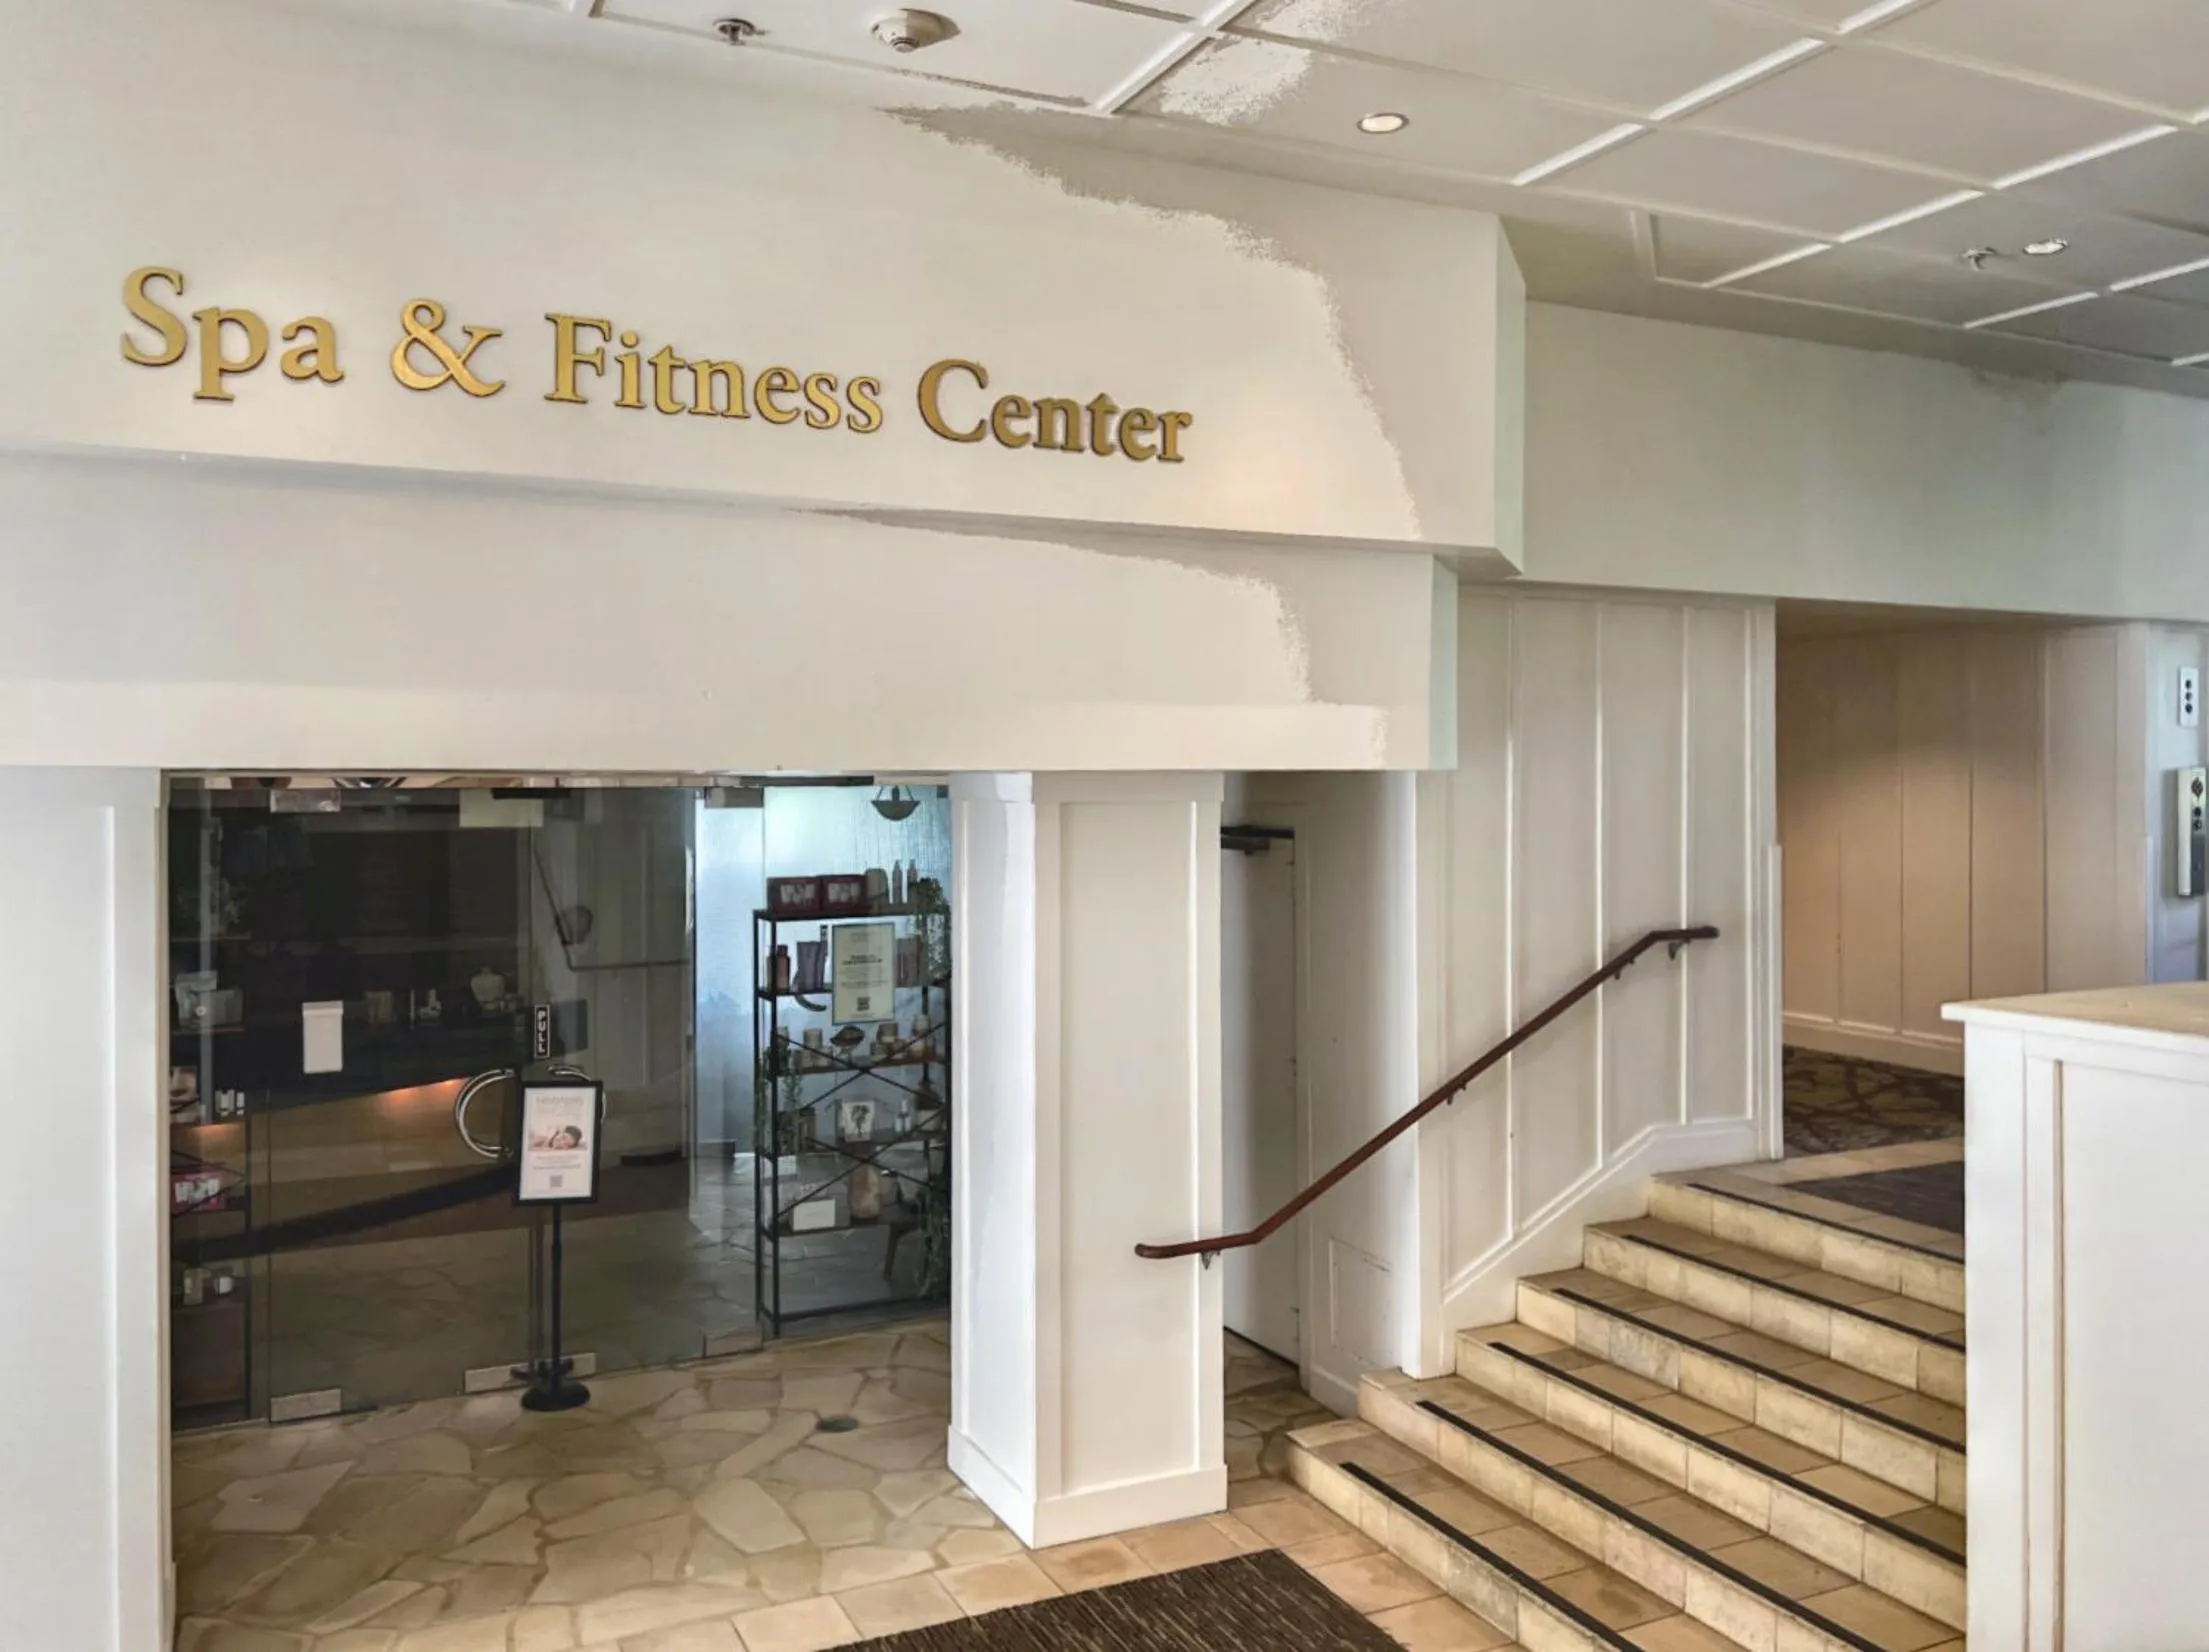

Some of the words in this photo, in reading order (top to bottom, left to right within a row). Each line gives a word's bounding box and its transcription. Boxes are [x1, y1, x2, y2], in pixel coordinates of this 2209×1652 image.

[121, 265, 345, 403] Spa
[388, 298, 505, 398] &
[544, 312, 884, 435] Fitness
[916, 357, 1194, 464] Center
[537, 1009, 547, 1054] PULL
